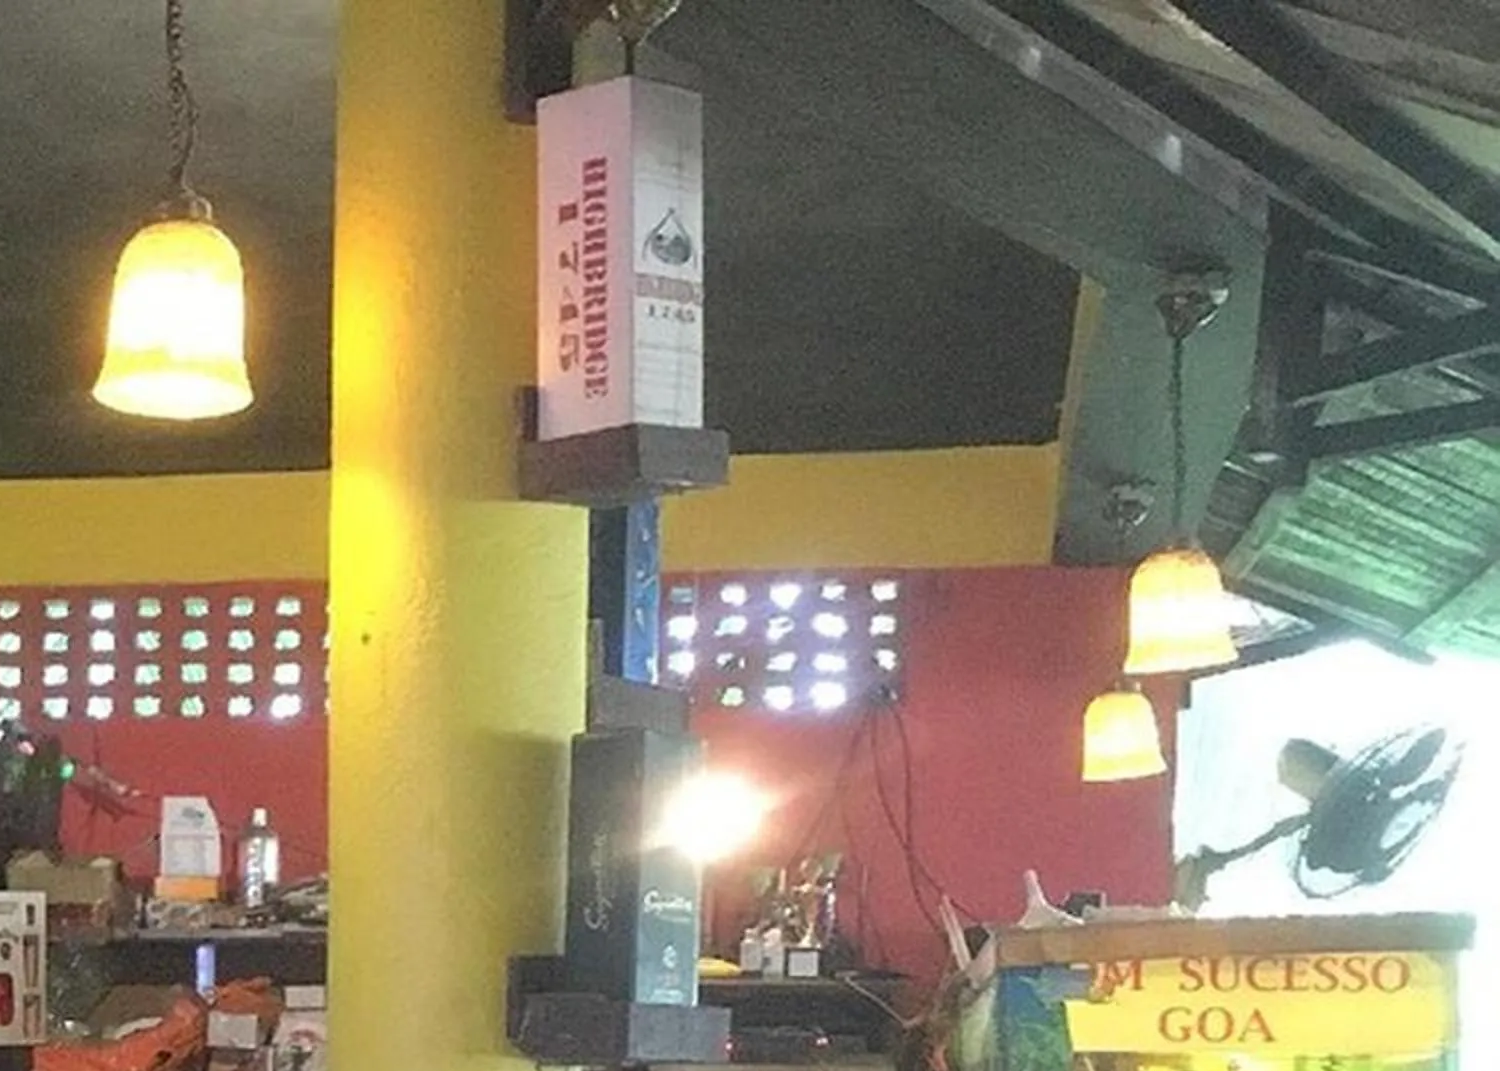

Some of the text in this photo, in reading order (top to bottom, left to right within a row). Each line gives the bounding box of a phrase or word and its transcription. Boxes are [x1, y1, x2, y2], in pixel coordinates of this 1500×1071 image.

[558, 202, 580, 372] 1745
[583, 157, 608, 398] HIGHBRIDGE
[1158, 1006, 1275, 1043] GOA
[1179, 955, 1411, 993] SUCESSO
